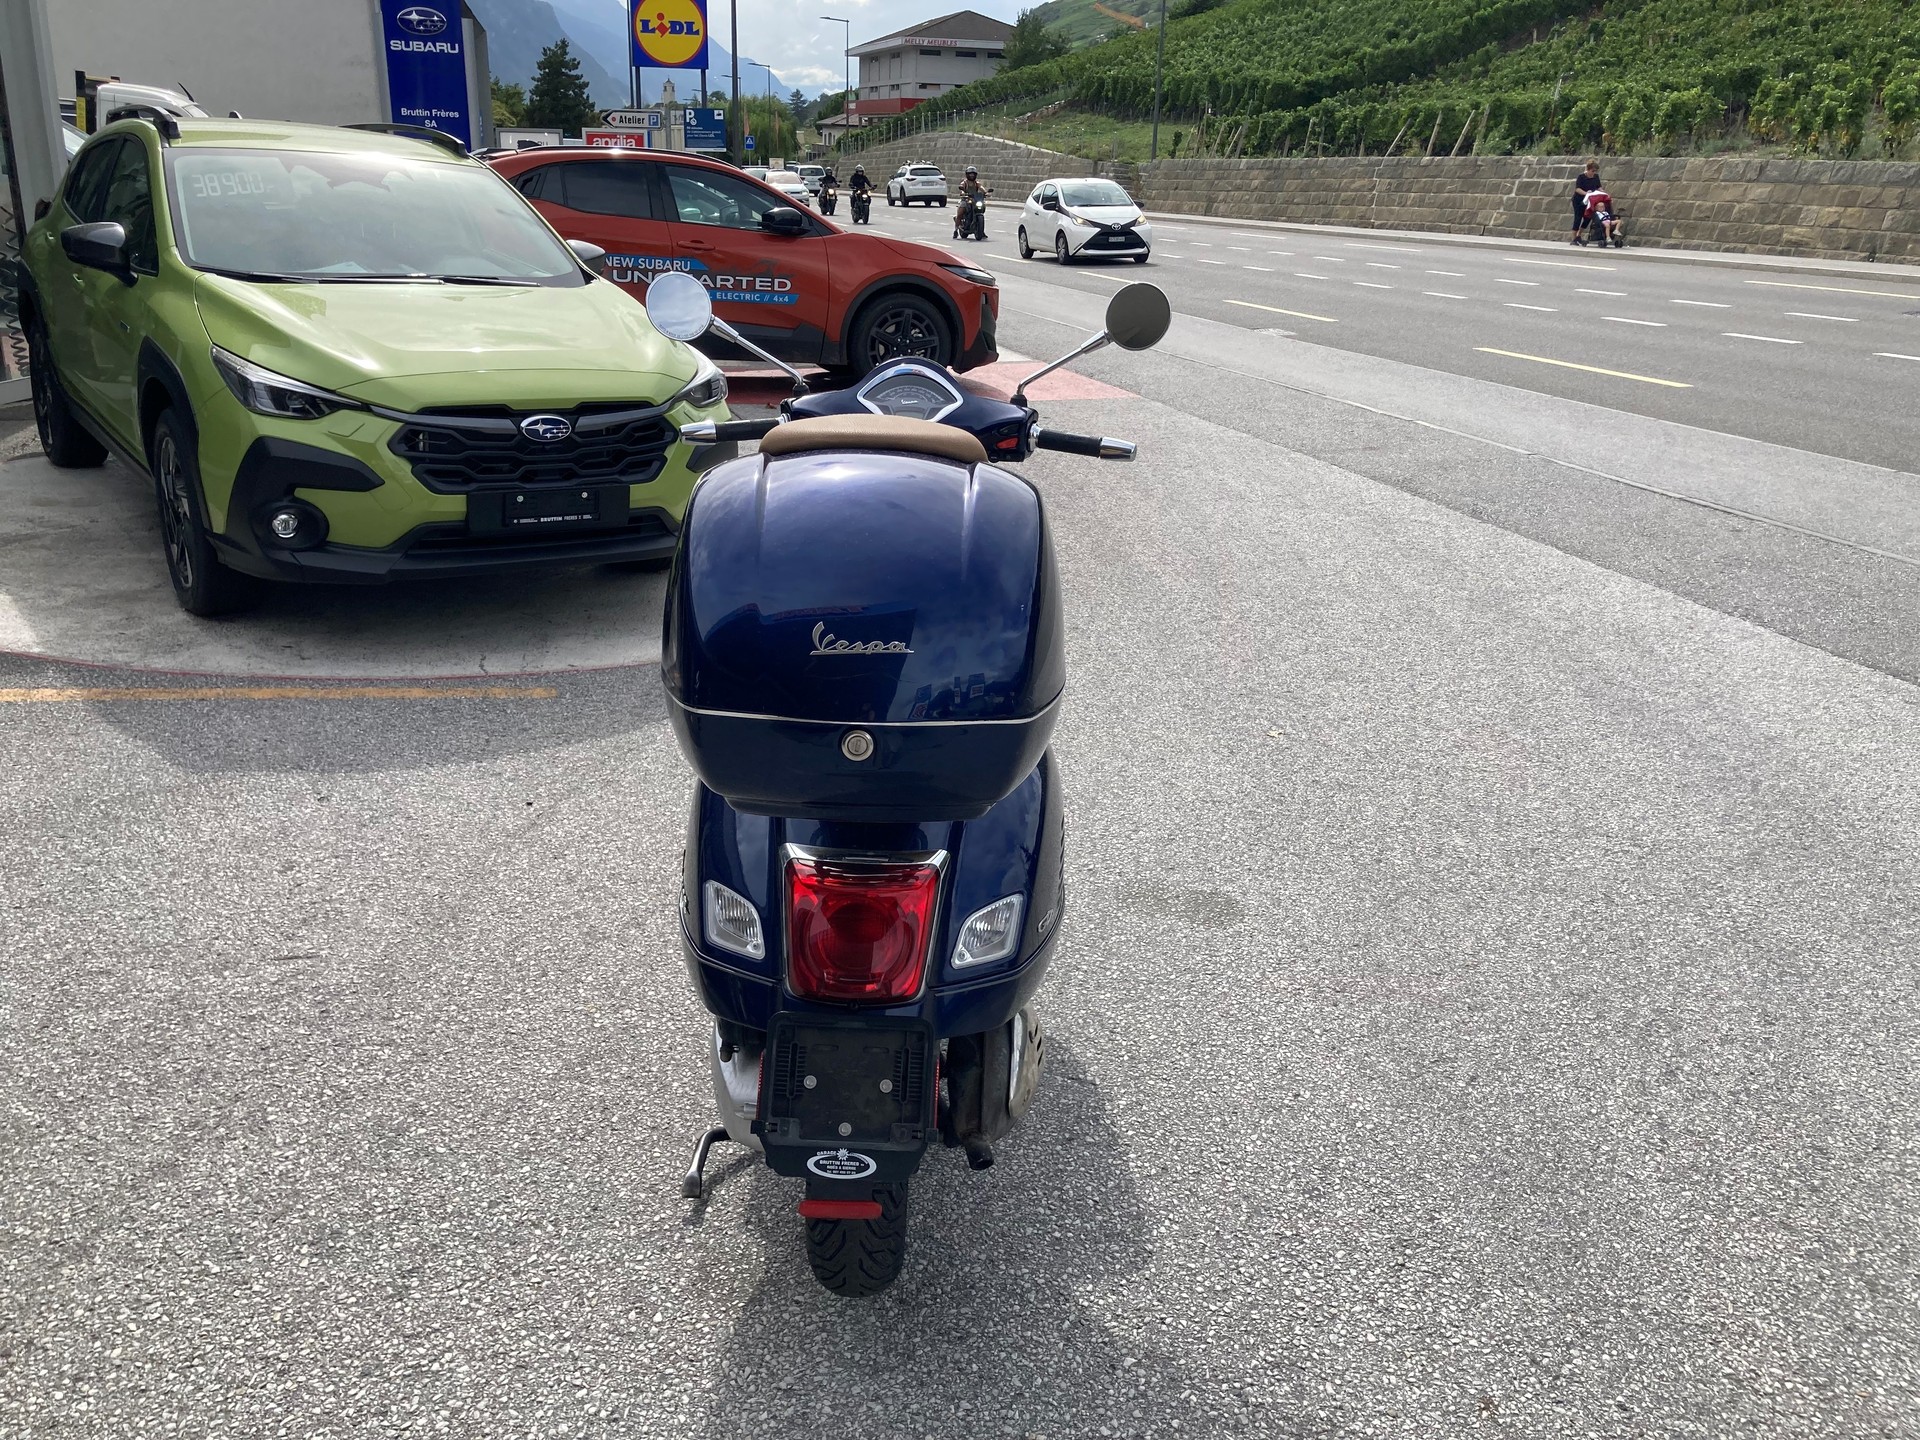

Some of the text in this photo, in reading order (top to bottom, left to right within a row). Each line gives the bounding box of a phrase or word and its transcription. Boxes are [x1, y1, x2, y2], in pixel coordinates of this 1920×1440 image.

[390, 40, 459, 54] SUBARU
[401, 107, 459, 118] Bruttin Frères
[424, 119, 437, 128] SA
[618, 115, 657, 125] Atelier P
[592, 134, 636, 148] aprilia
[606, 256, 690, 272] NEW SUBARU
[612, 269, 792, 292] UNARTED
[716, 292, 760, 301] ELECTRIC
[809, 621, 915, 655] Vespa
